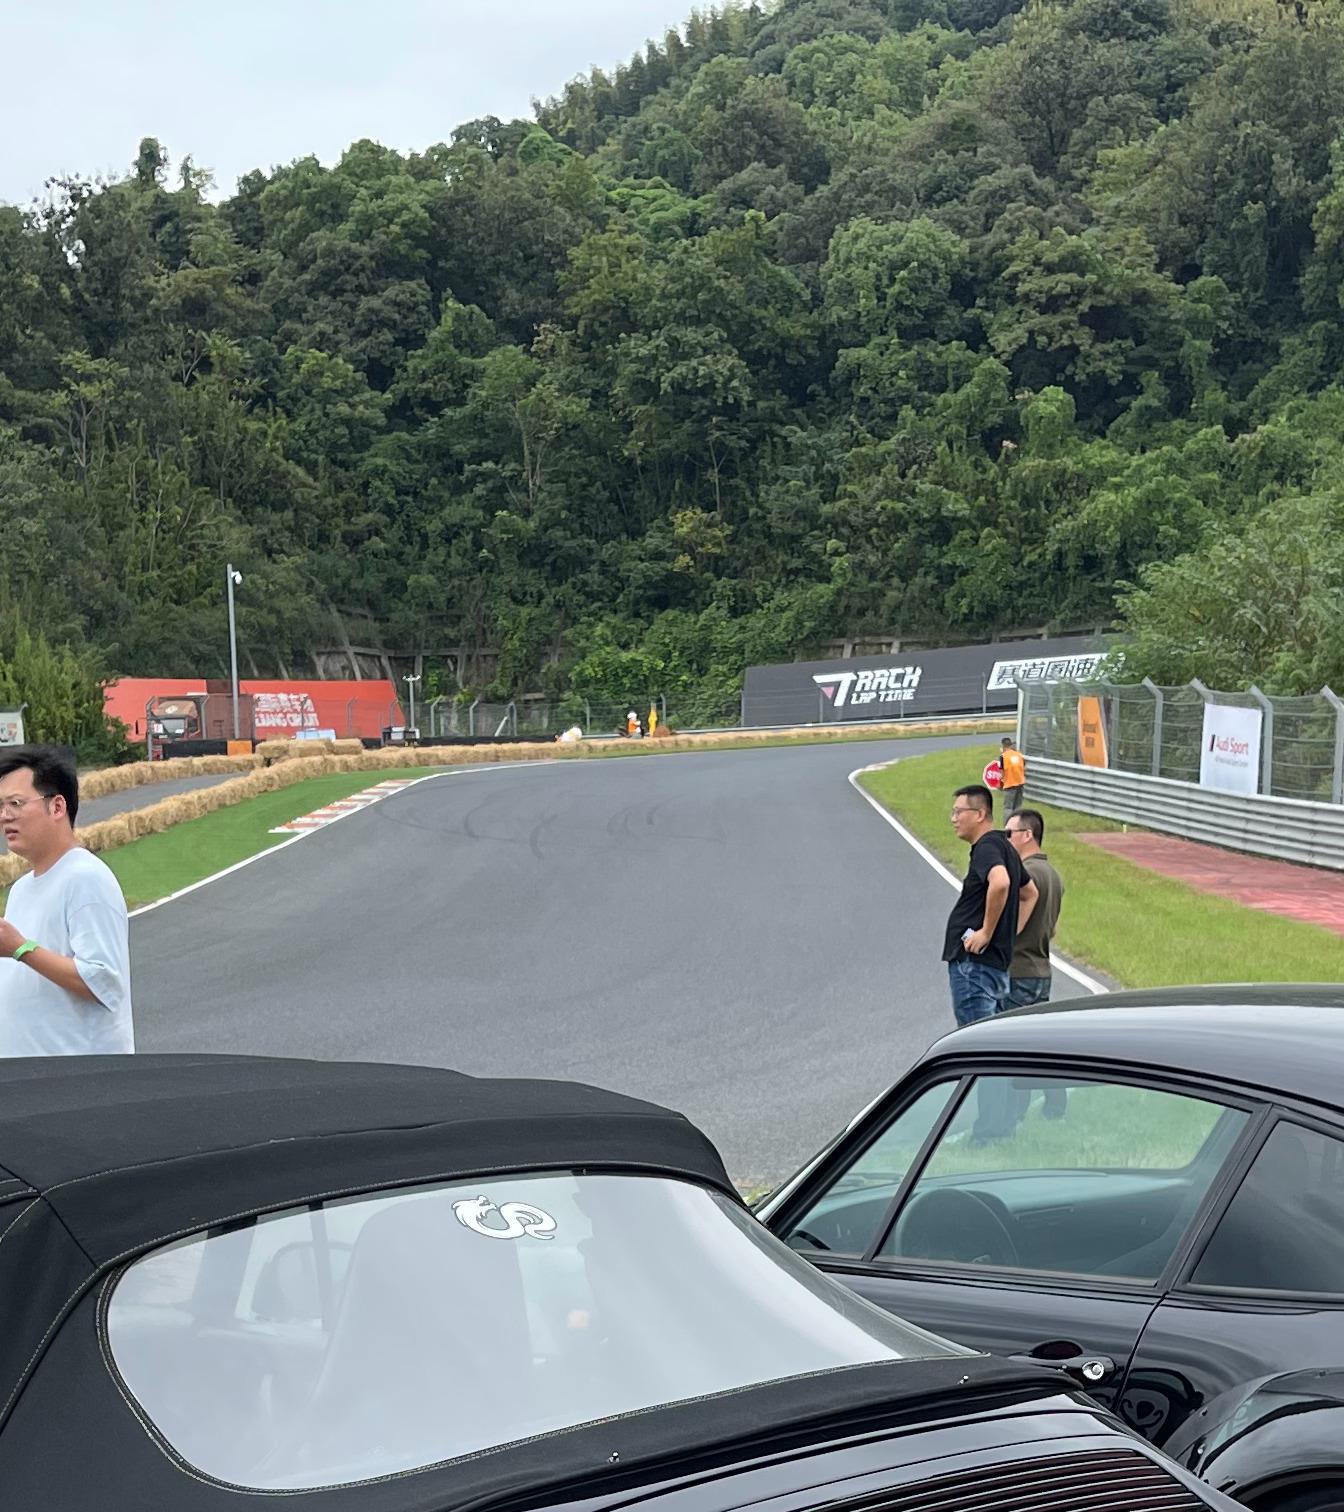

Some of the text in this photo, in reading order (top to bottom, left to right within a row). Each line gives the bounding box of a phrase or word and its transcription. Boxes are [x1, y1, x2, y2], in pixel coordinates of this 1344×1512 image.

[995, 657, 1114, 686] 赛道圈速
[851, 688, 916, 705] LAP TIME
